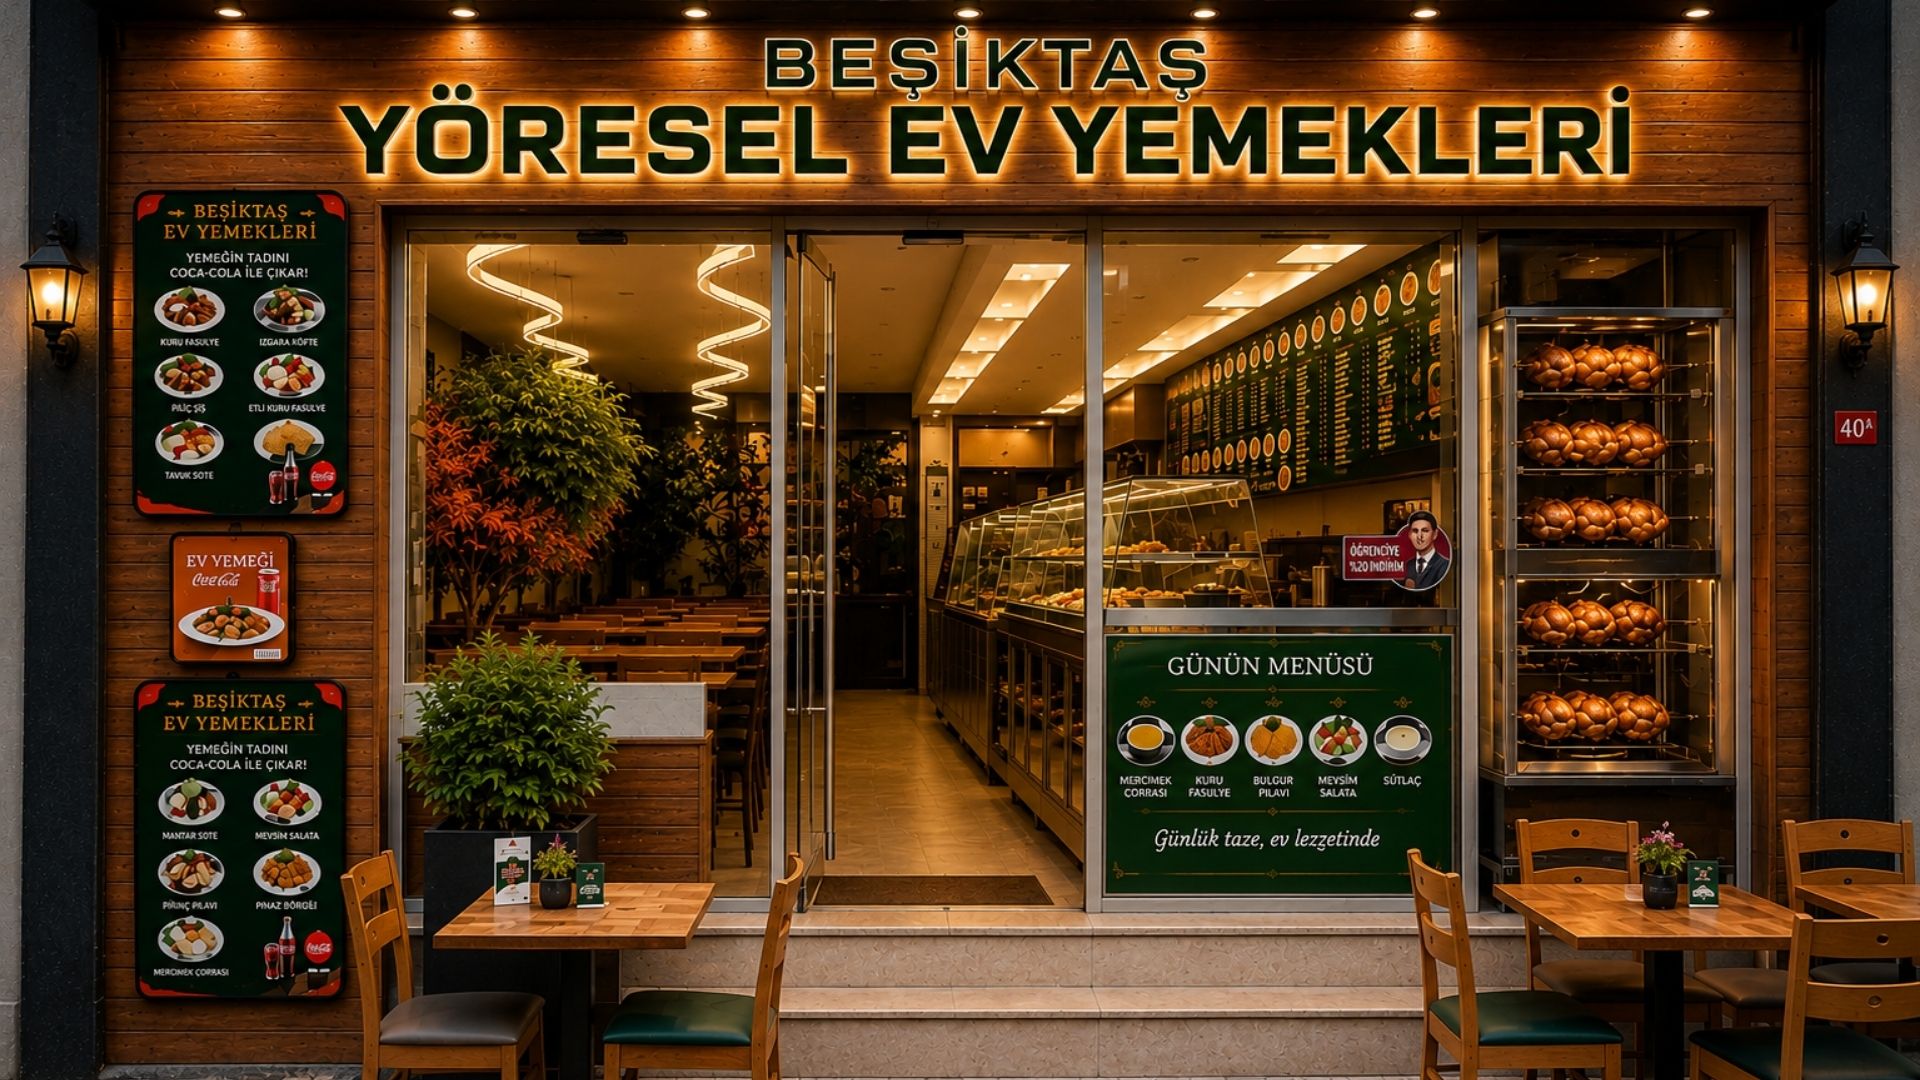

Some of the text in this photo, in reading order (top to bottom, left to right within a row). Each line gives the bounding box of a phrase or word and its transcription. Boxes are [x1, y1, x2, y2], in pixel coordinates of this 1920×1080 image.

[764, 25, 1208, 101] BEŞİKTAŞ
[338, 83, 1632, 175] YÖRESEL EV YEMEKLERİ
[194, 200, 288, 222] BEŞİKTAŞ
[164, 221, 317, 240] EV YEMEKLERİ
[186, 250, 289, 263] YEMEĞİN TADINI
[170, 264, 308, 281] COCA-COLA İLE ÇIKAR!
[187, 551, 274, 567] EV YEMEĞİ
[1168, 652, 1374, 676] GÜNÜN MENÜSÜ
[193, 690, 287, 712] BEŞİKTAŞ
[164, 712, 315, 731] EV YEMEKLERİ
[186, 741, 288, 755] YEMEĞİN TADINI
[170, 756, 307, 772] COCA-COLA İLE ÇIKAR!
[1195, 776, 1224, 786] KURU
[1253, 776, 1294, 785] BULGUR
[1188, 788, 1231, 798] FASULYE
[1320, 788, 1357, 798] SALATA
[1155, 828, 1381, 852] Günlük taze, ev lezzetinde
